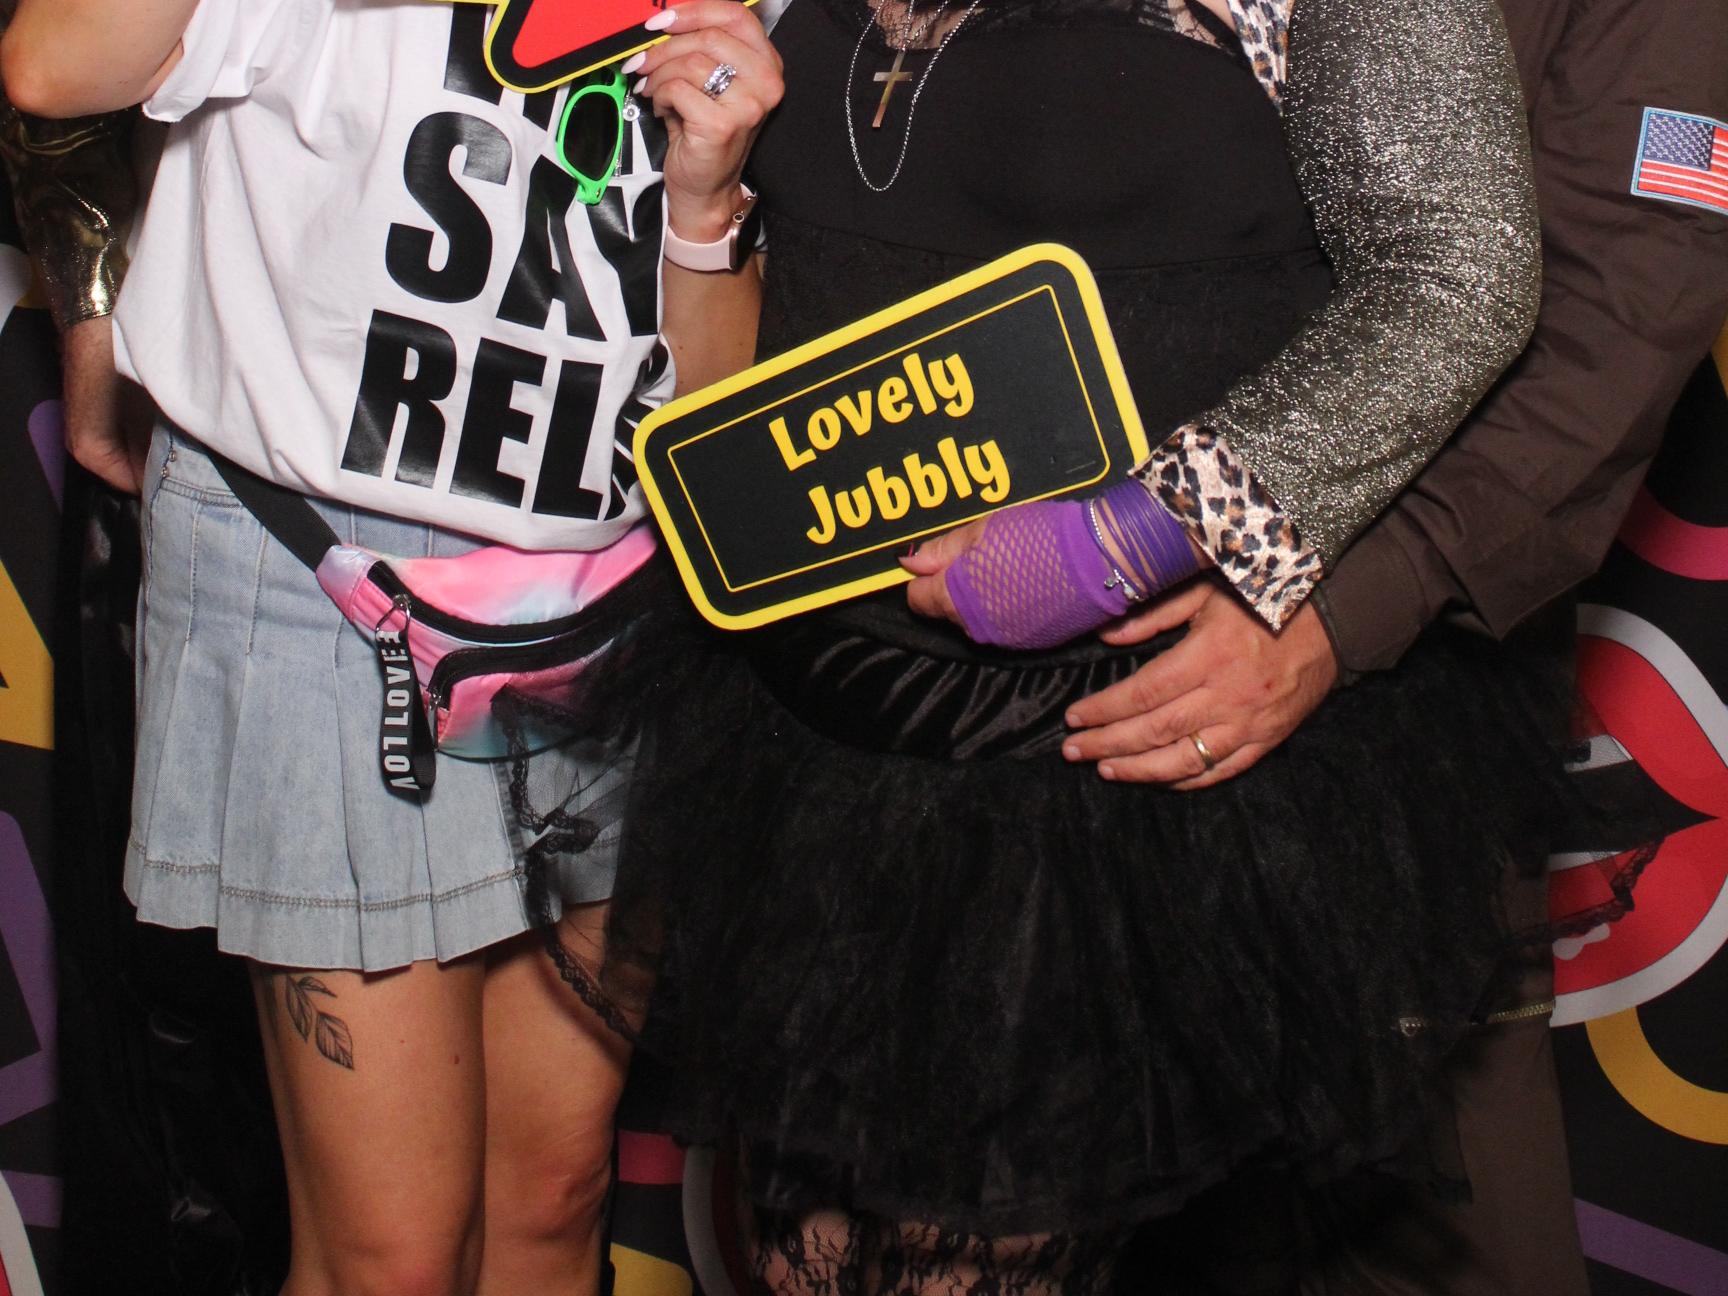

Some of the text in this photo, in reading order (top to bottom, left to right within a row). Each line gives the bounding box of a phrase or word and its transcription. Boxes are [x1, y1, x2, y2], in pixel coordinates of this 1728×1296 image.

[385, 111, 665, 342] SAY
[768, 352, 975, 471] Lovely
[806, 437, 1011, 545] Jubbly
[381, 648, 411, 727] LOVE
